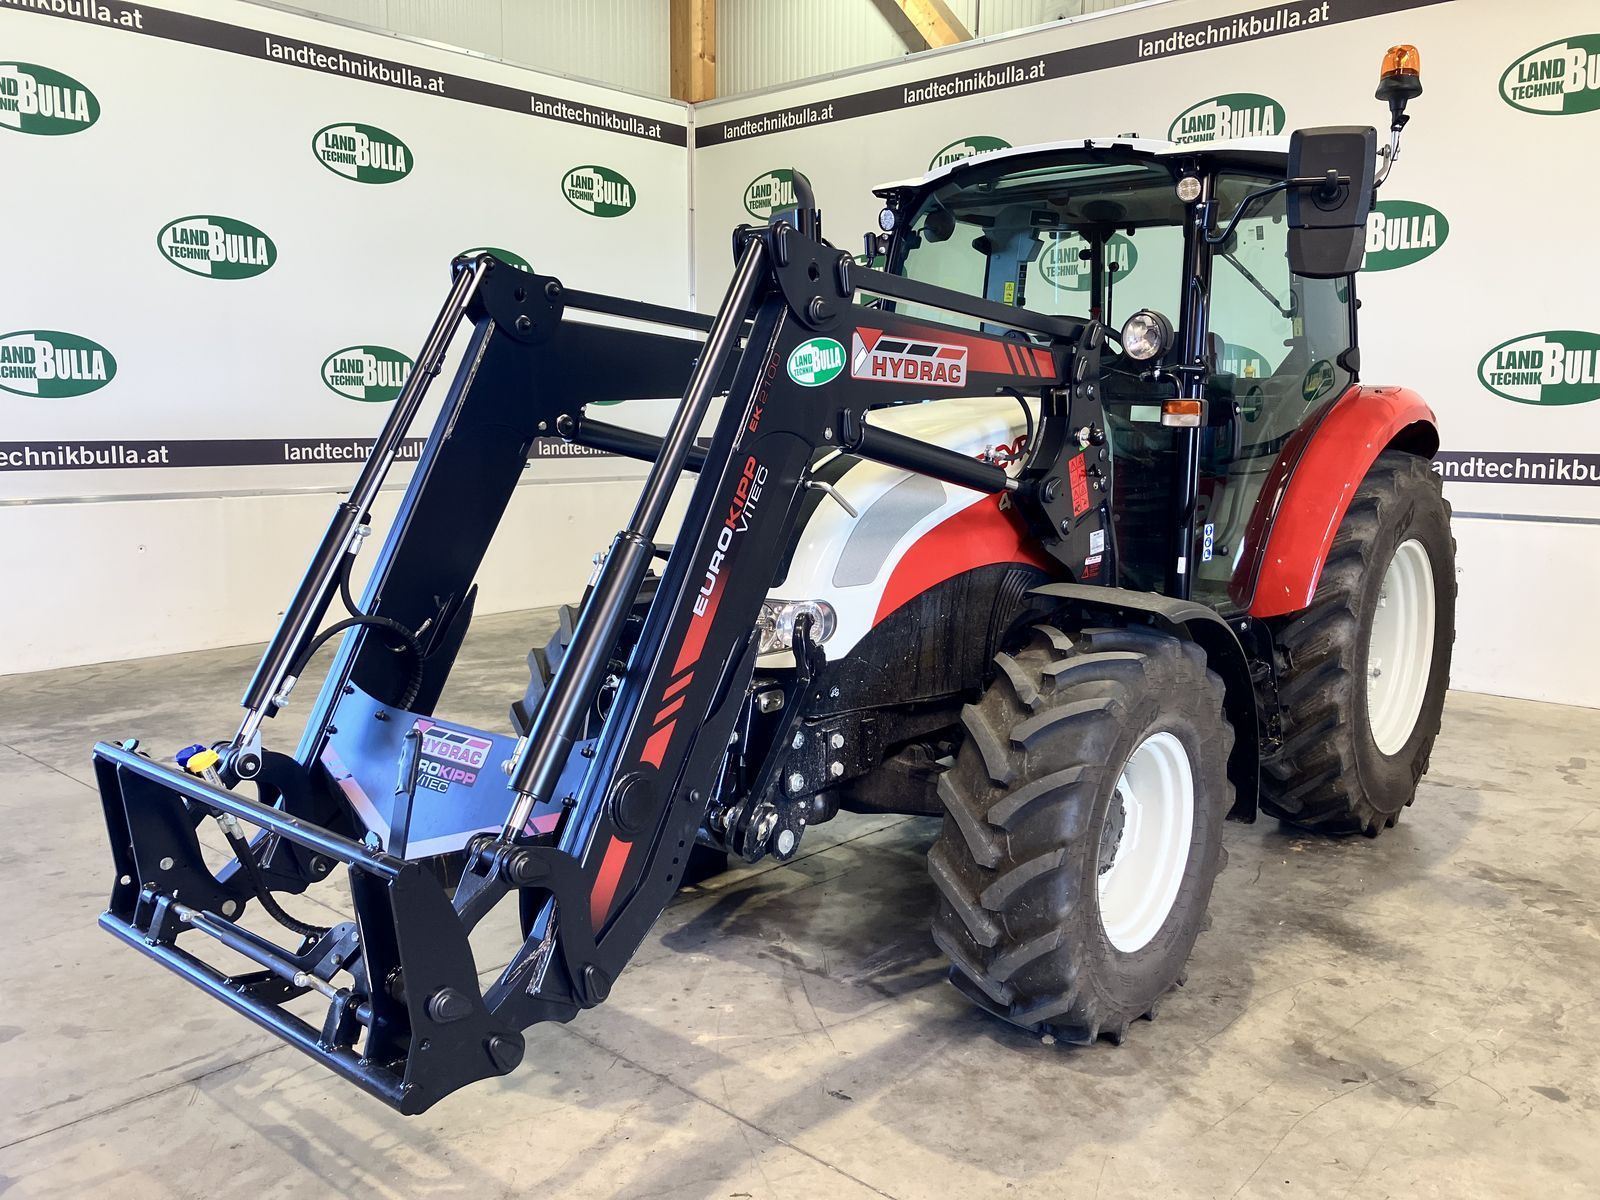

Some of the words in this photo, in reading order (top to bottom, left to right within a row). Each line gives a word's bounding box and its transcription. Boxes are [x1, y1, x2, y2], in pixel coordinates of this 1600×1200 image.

[1138, 1, 1330, 57] landtechnikbulla.at
[265, 37, 445, 93] landtechnikbulla.at
[1518, 58, 1566, 83] LAND
[904, 60, 1046, 103] landtechnikbulla.at
[1511, 80, 1564, 100] TECHNIK
[18, 72, 90, 122] BULLA
[531, 96, 661, 138] landtechnikbulla.at
[724, 104, 834, 139] landtechnikbulla.at
[1181, 113, 1216, 134] LAND
[1216, 105, 1275, 139] BULLA
[325, 133, 357, 152] LAND
[356, 132, 406, 172] BULLA
[321, 150, 357, 165] TECHNIK
[571, 174, 594, 190] LAND
[593, 173, 630, 207] BULLA
[751, 184, 771, 199] LAND
[568, 189, 594, 202] TECHNIK
[172, 227, 209, 246] LAND
[1365, 212, 1436, 252] BULLA
[168, 246, 210, 260] TECHNIK
[208, 225, 268, 265] BULLA
[1050, 247, 1079, 264] LAND
[35, 341, 106, 380] BULLA
[333, 359, 364, 373] LAND
[795, 353, 813, 367] LAND
[811, 346, 842, 372] BULLA
[872, 355, 961, 383] HYDRAC
[1496, 350, 1544, 370] LAND
[330, 375, 364, 386] TECHNIK
[1490, 372, 1542, 385] TECHNIK
[749, 406, 763, 432] EK
[759, 353, 781, 404] 2100
[693, 456, 756, 618] EUROKIPP
